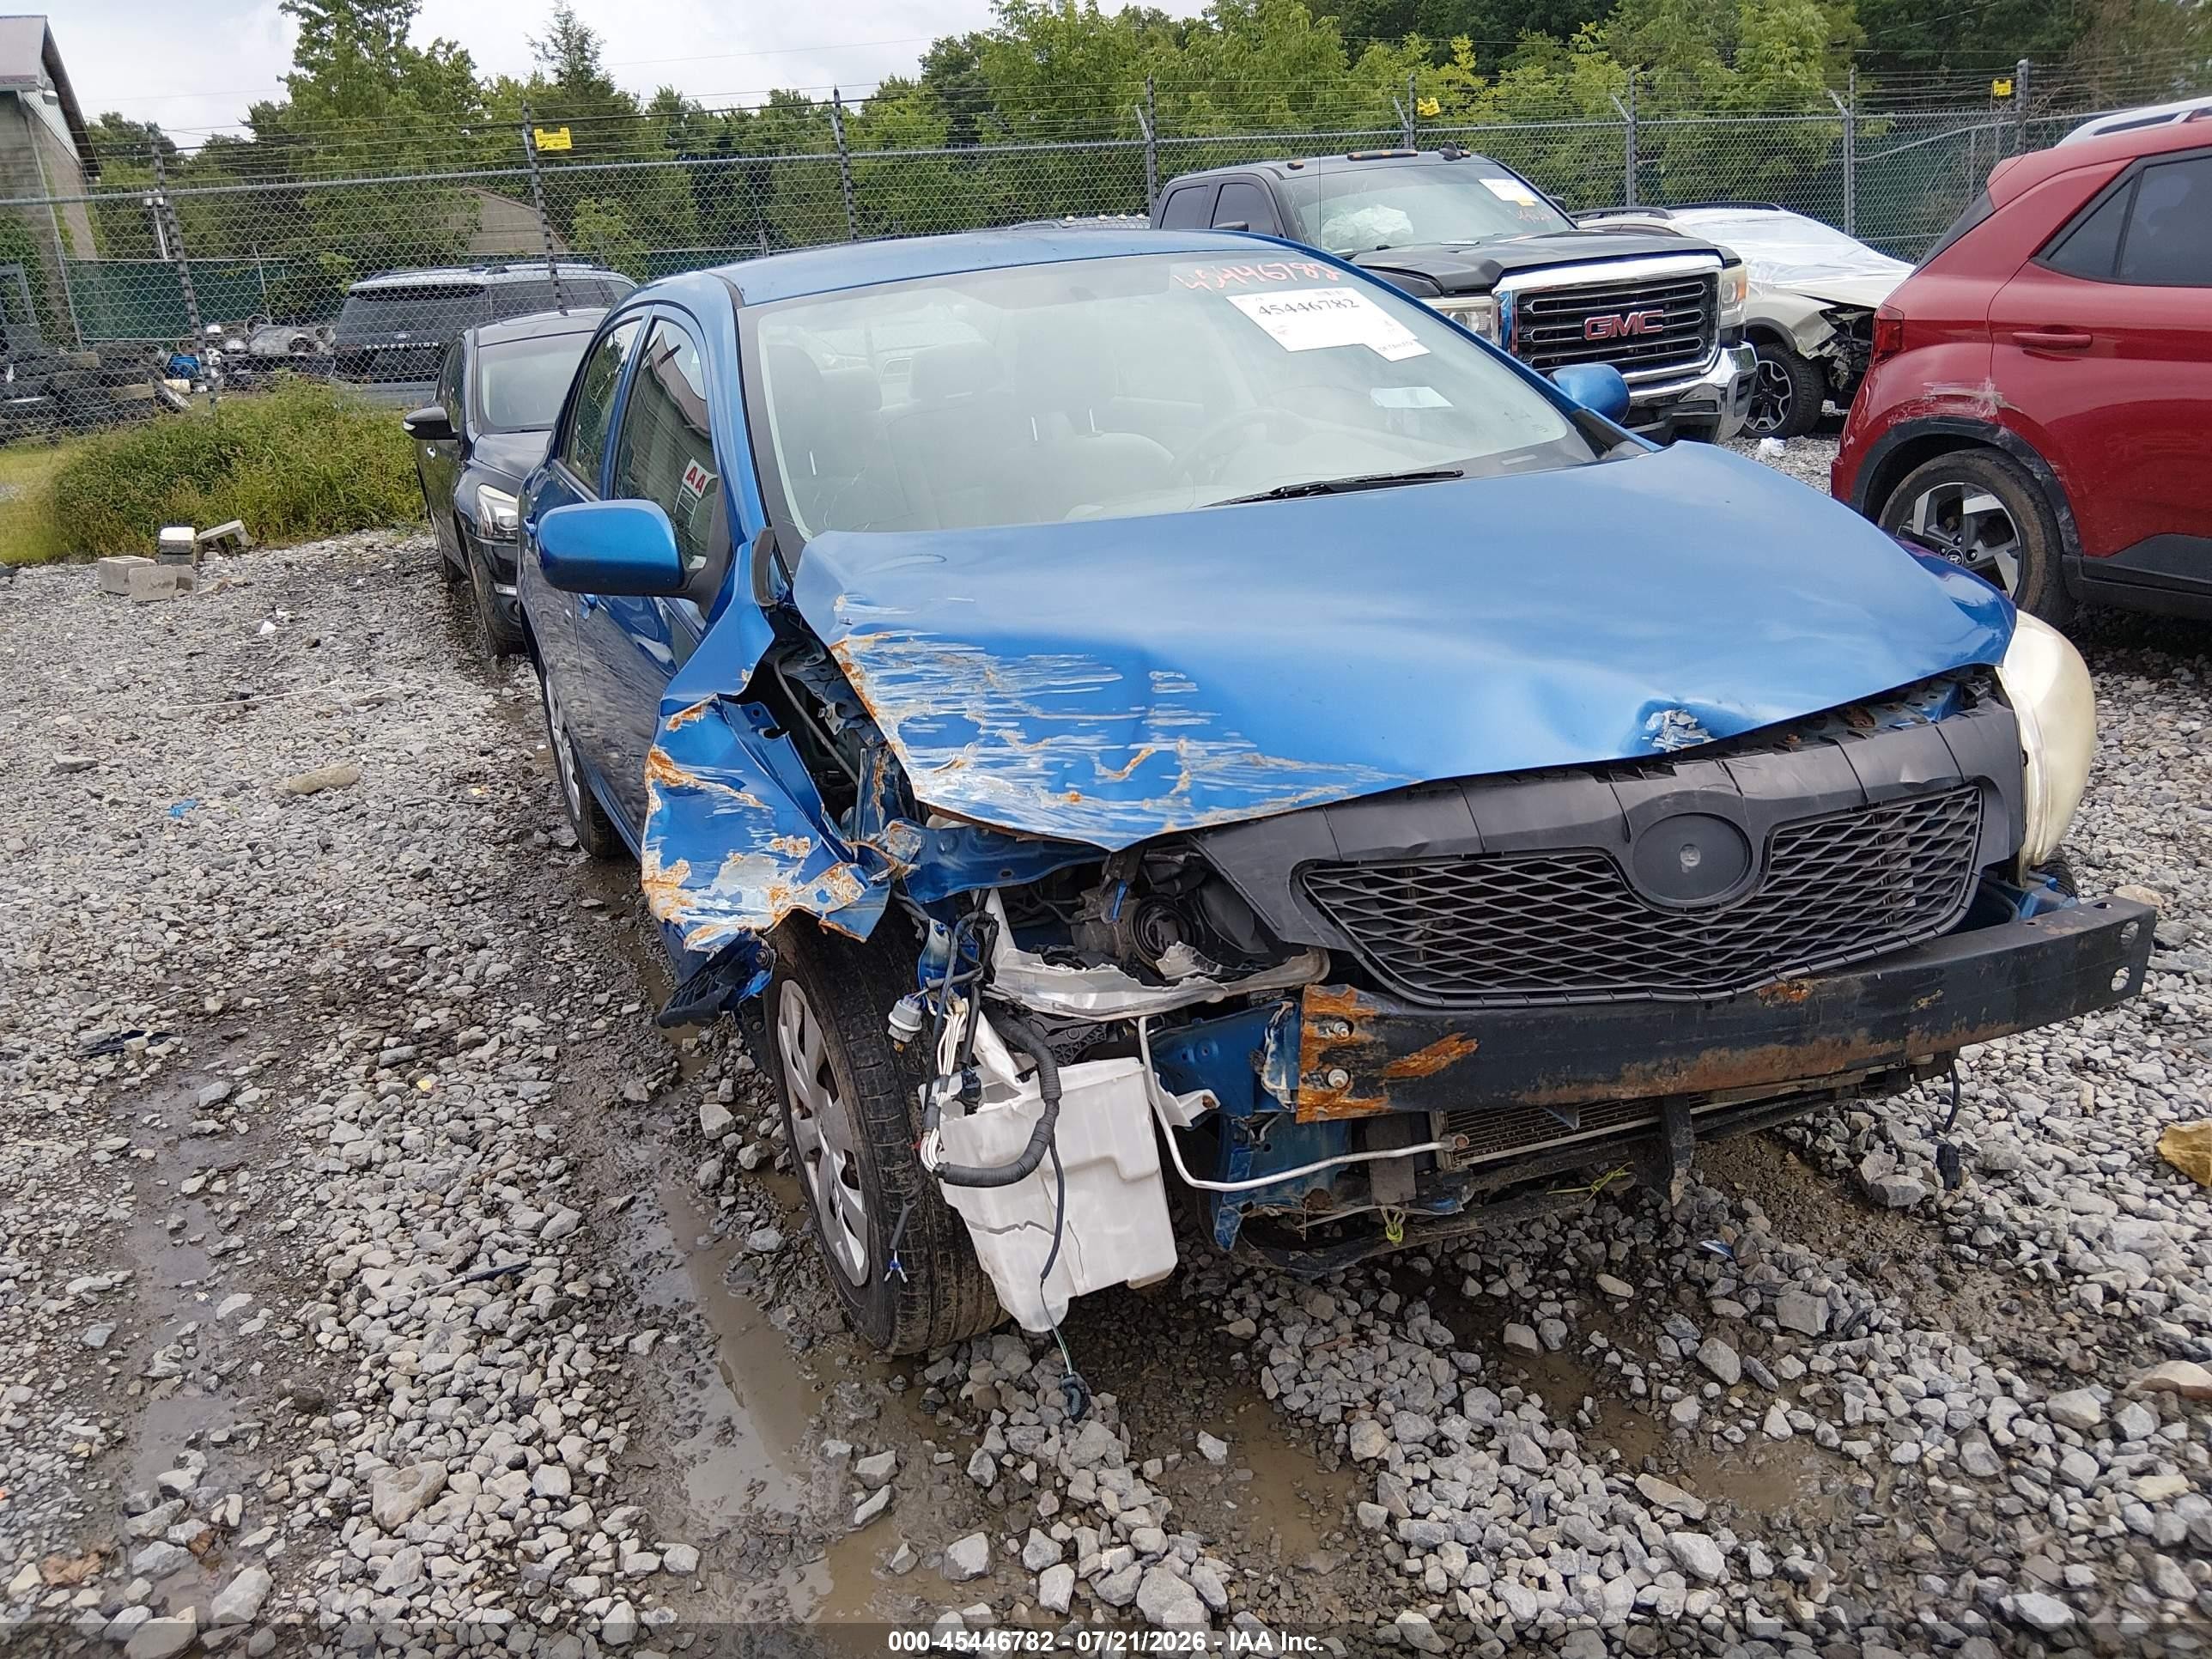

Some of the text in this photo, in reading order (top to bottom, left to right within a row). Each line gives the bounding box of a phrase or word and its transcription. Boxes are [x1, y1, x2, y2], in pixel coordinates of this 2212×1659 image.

[1173, 263, 1341, 294] 45446782
[1258, 298, 1360, 315] 45446782
[1584, 310, 1663, 341] GMC
